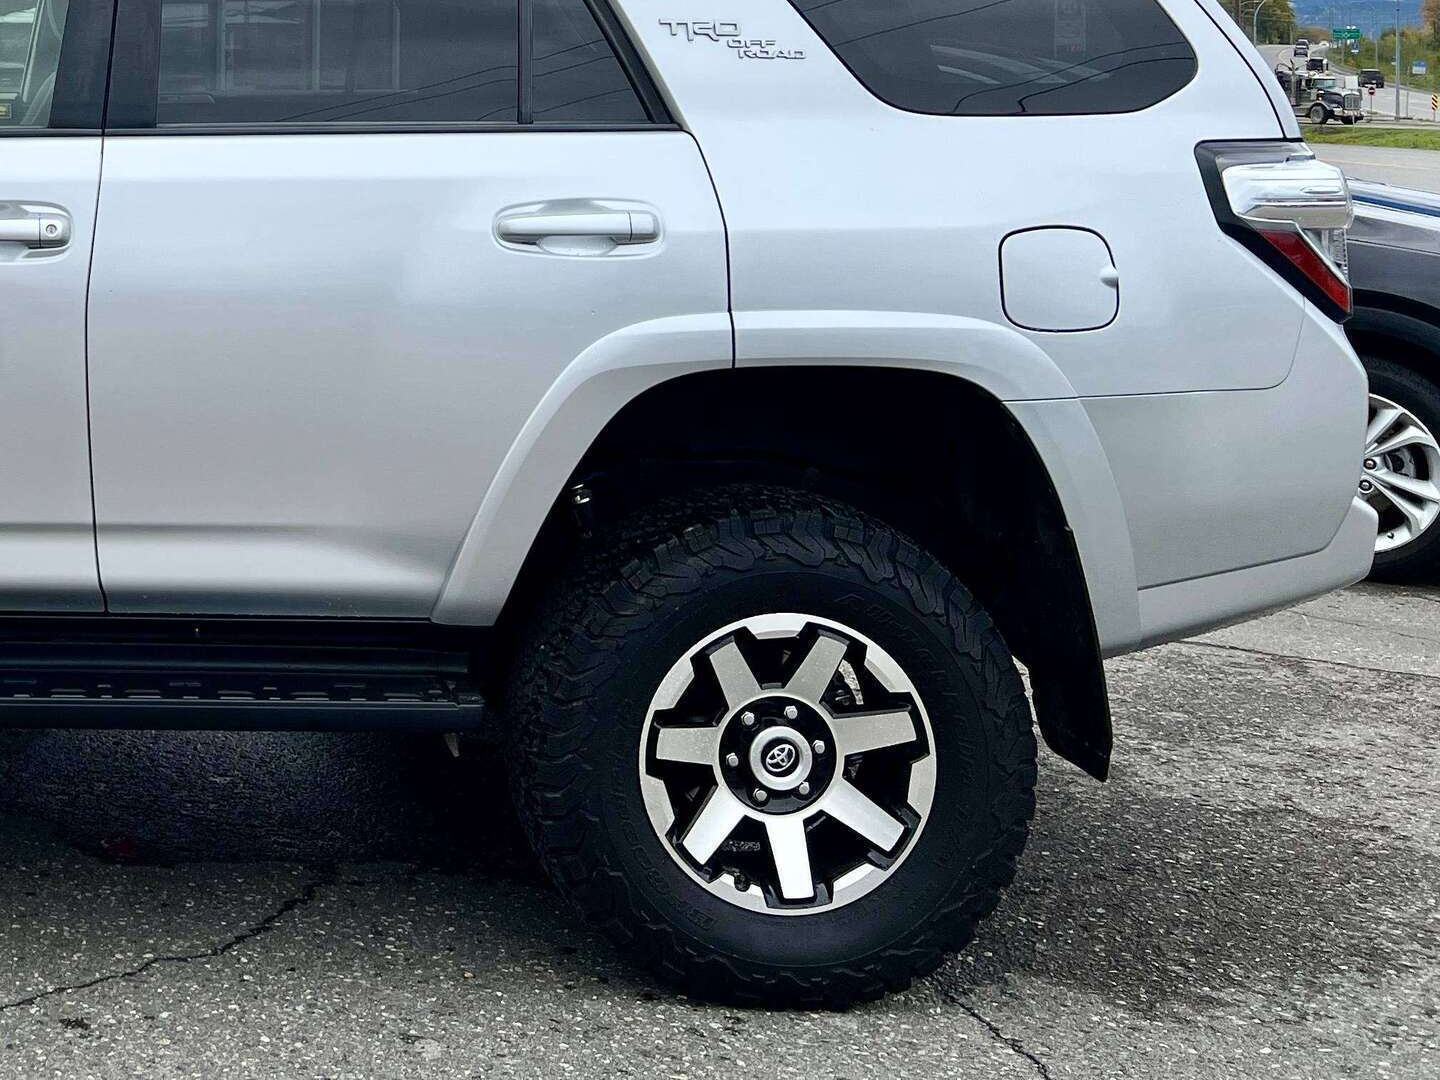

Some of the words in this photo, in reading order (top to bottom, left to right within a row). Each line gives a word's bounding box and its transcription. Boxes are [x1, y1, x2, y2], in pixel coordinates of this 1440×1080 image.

[658, 19, 741, 42] TRD
[727, 39, 776, 49] OFF
[738, 49, 807, 60] ROAD
